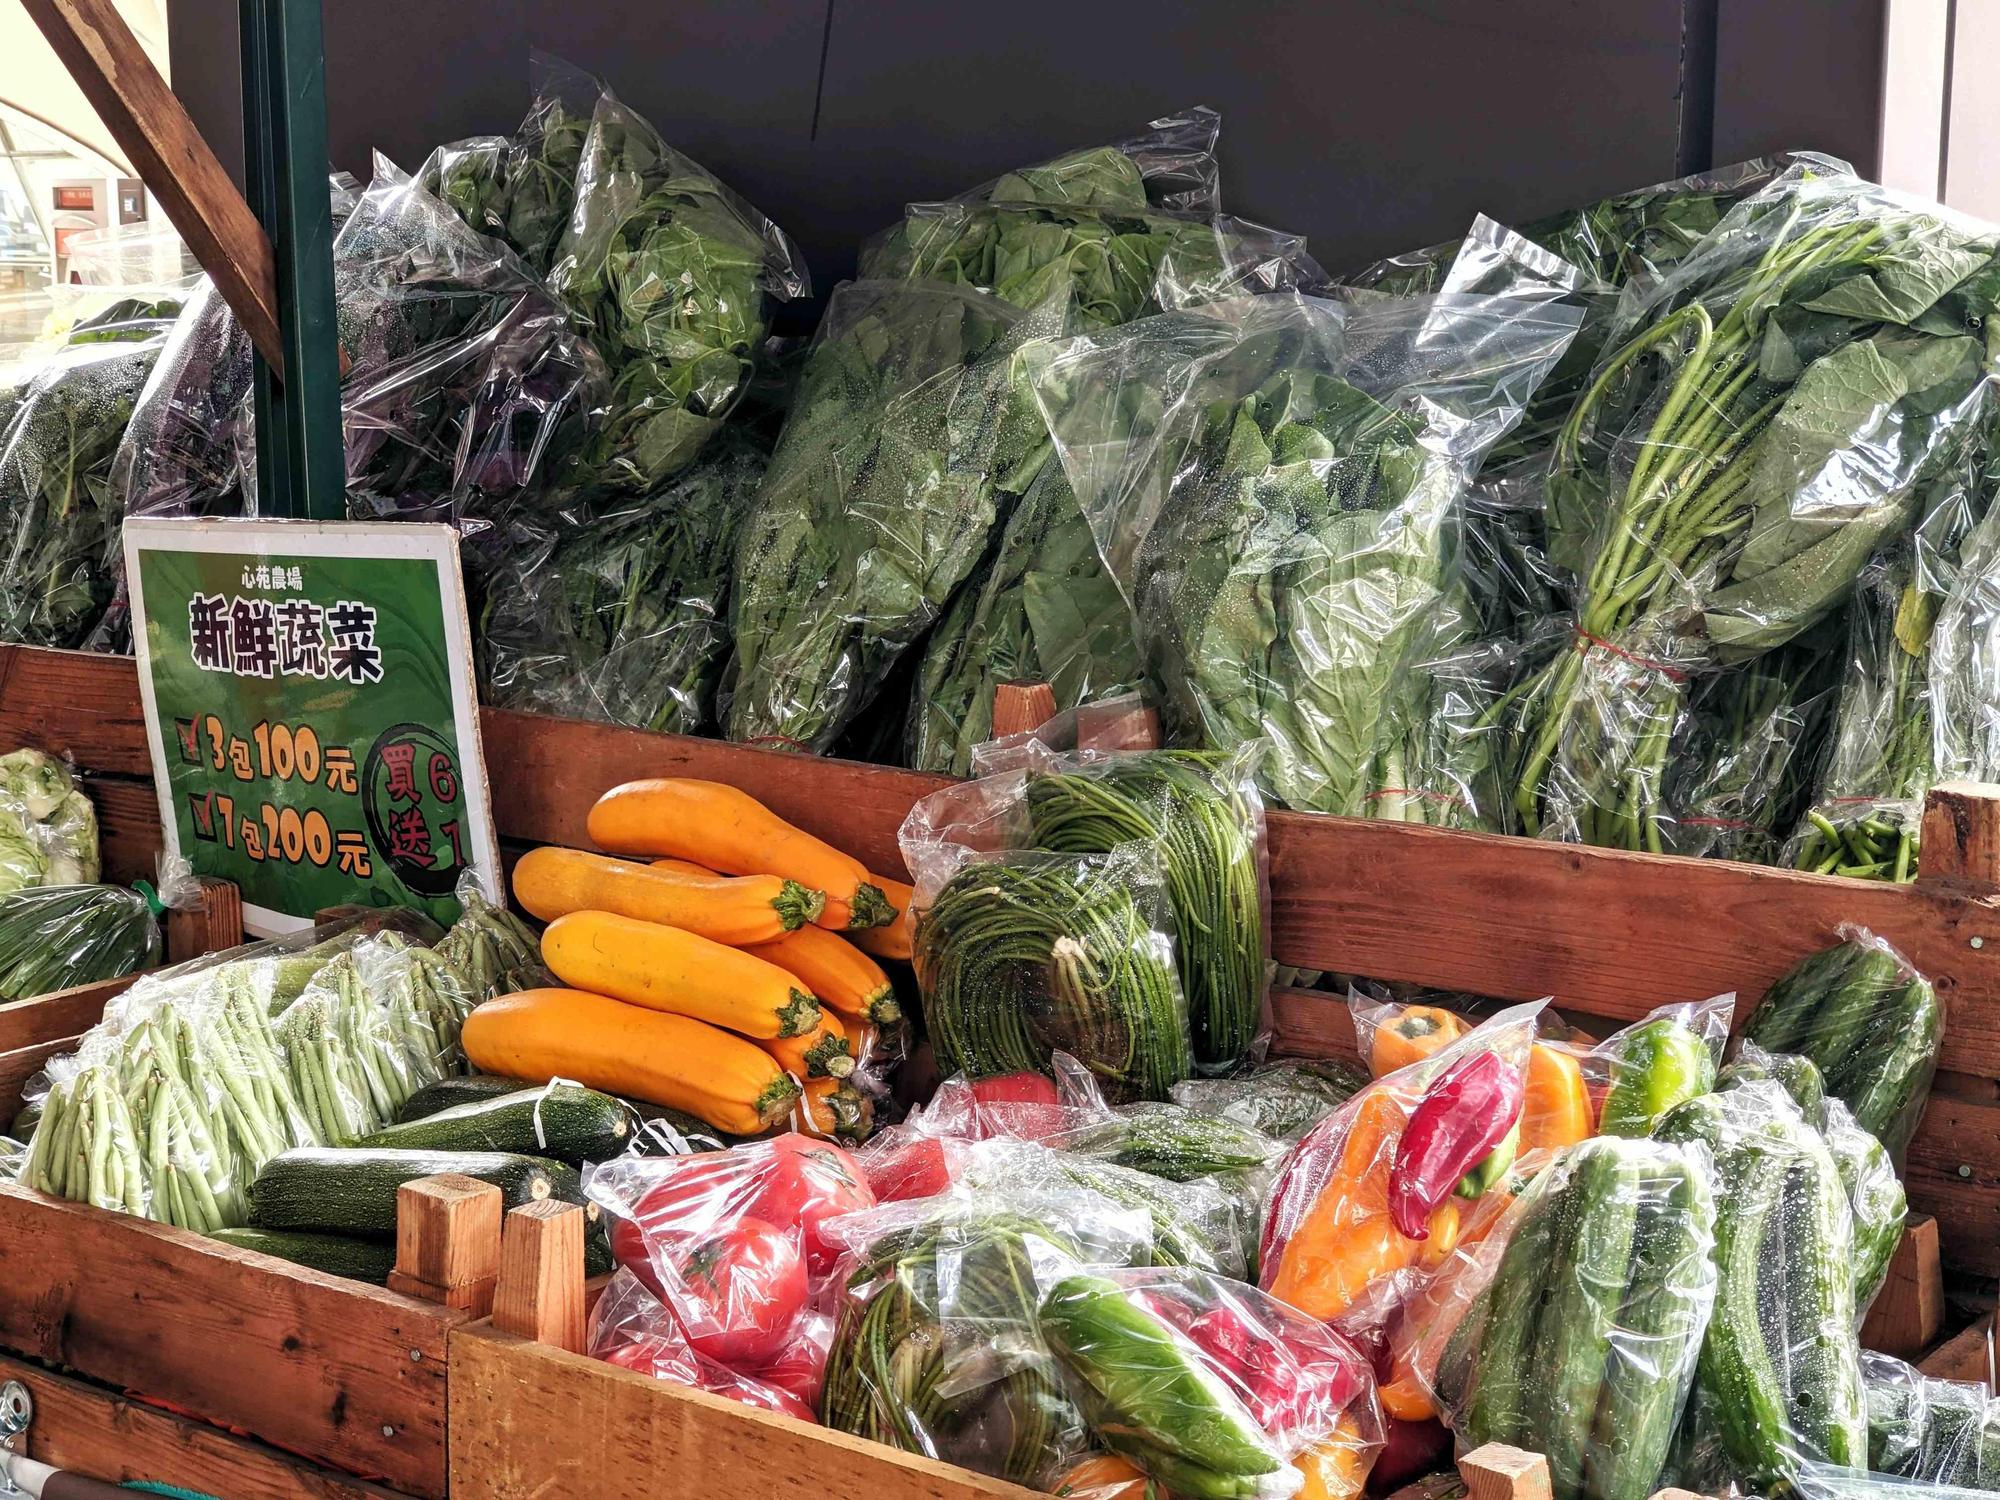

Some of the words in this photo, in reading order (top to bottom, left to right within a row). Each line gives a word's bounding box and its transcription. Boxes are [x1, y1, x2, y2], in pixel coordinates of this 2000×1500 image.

[241, 565, 302, 590] 心苑農場
[189, 592, 384, 684] 新鮮蔬菜
